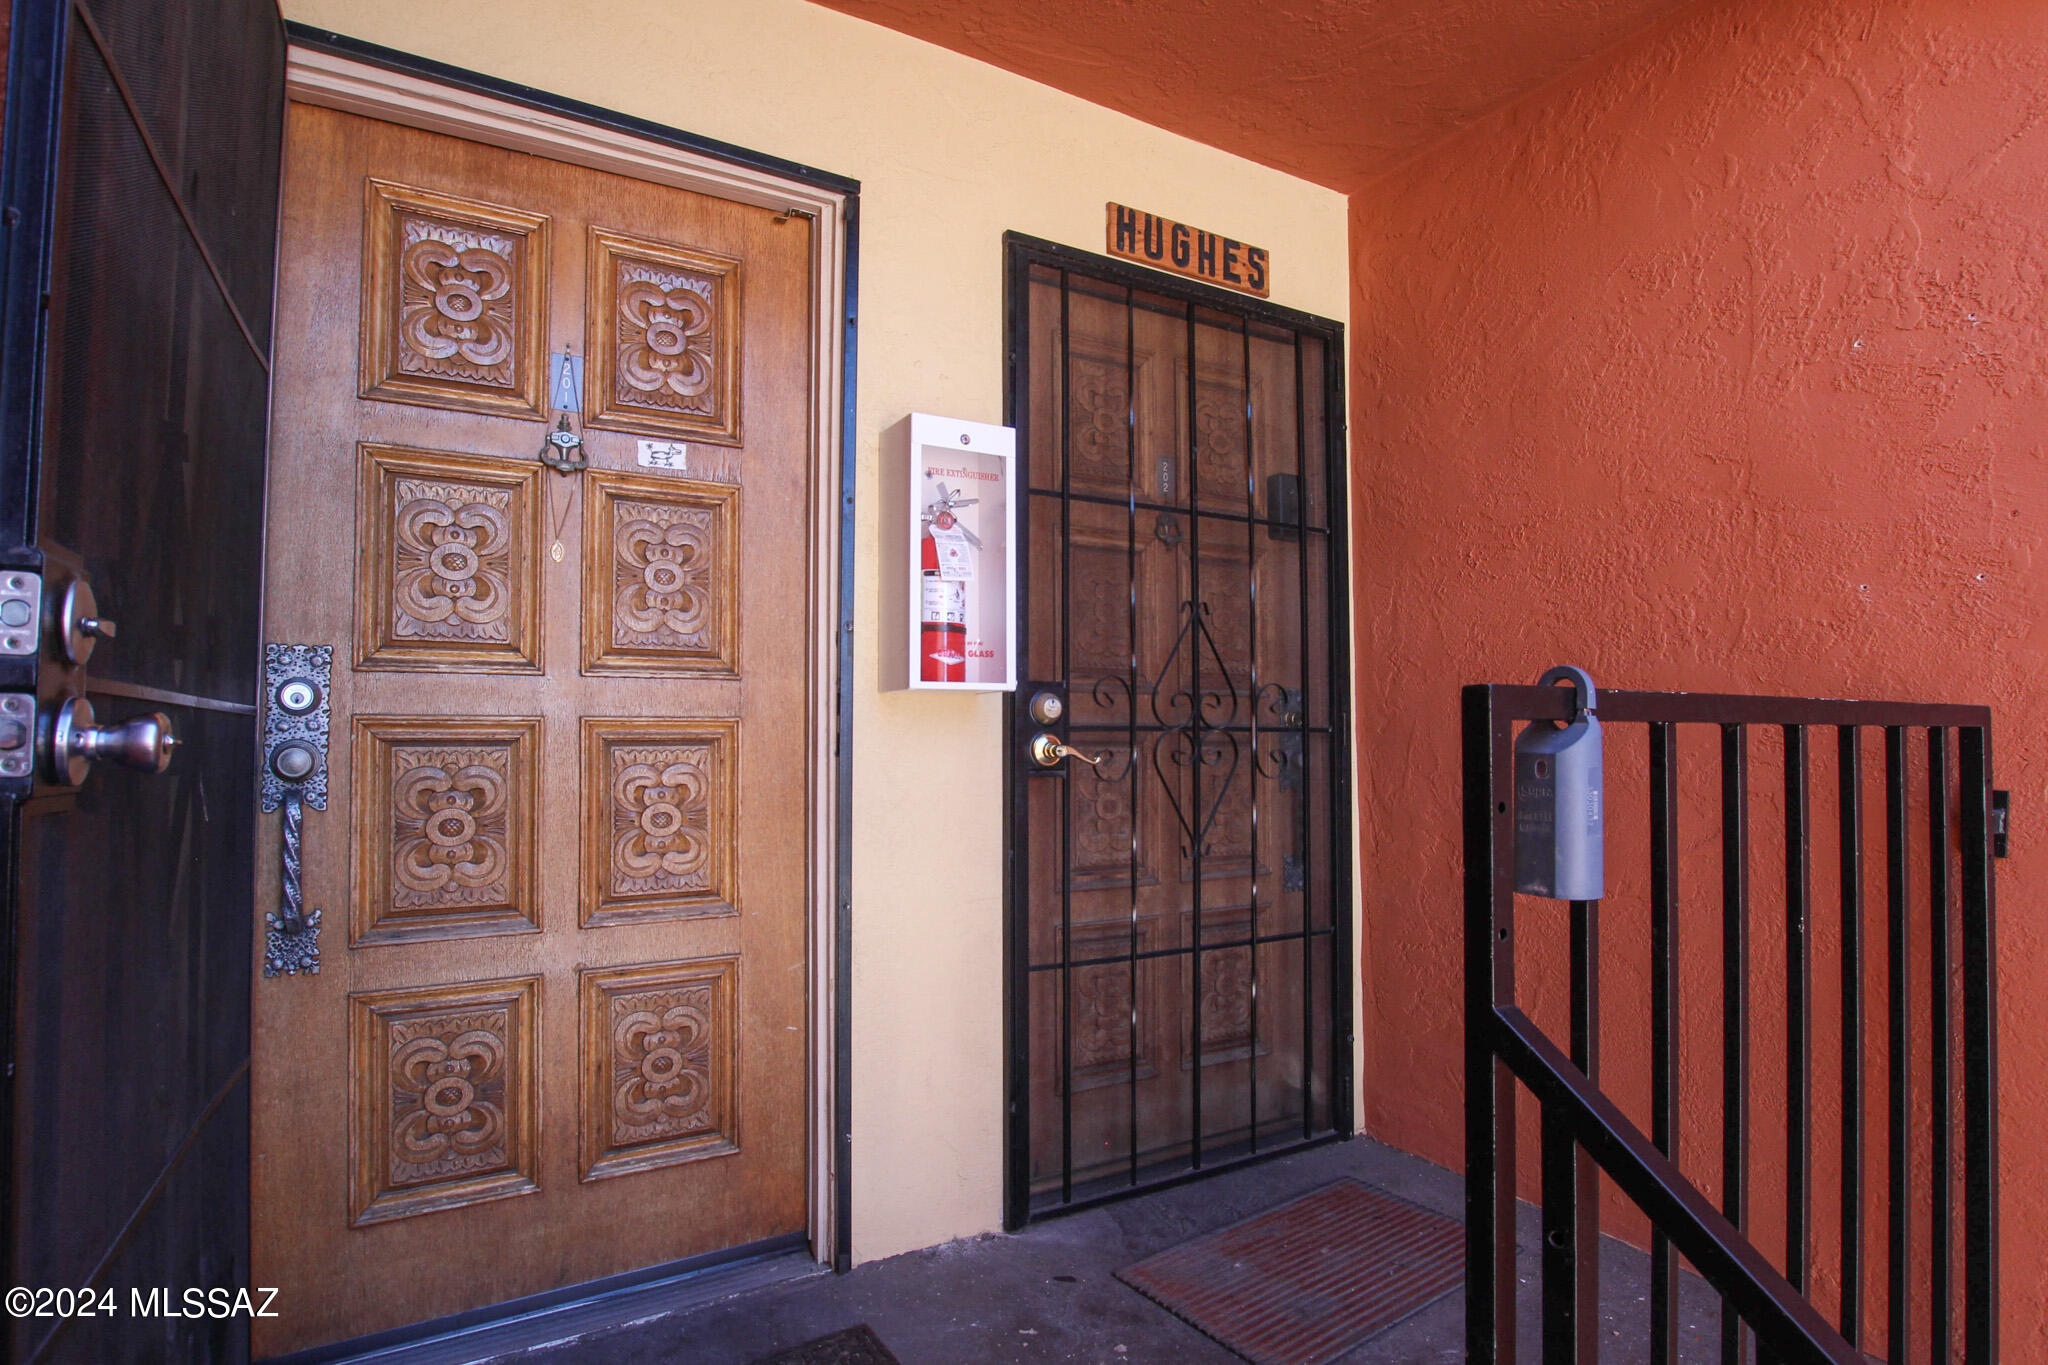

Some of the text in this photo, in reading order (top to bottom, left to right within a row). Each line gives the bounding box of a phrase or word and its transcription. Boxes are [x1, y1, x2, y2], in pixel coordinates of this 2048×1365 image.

[1116, 204, 1265, 290] HUGHES
[562, 363, 571, 402] 201
[946, 468, 1000, 482] EXTINGUISHER
[967, 649, 995, 658] GLASS
